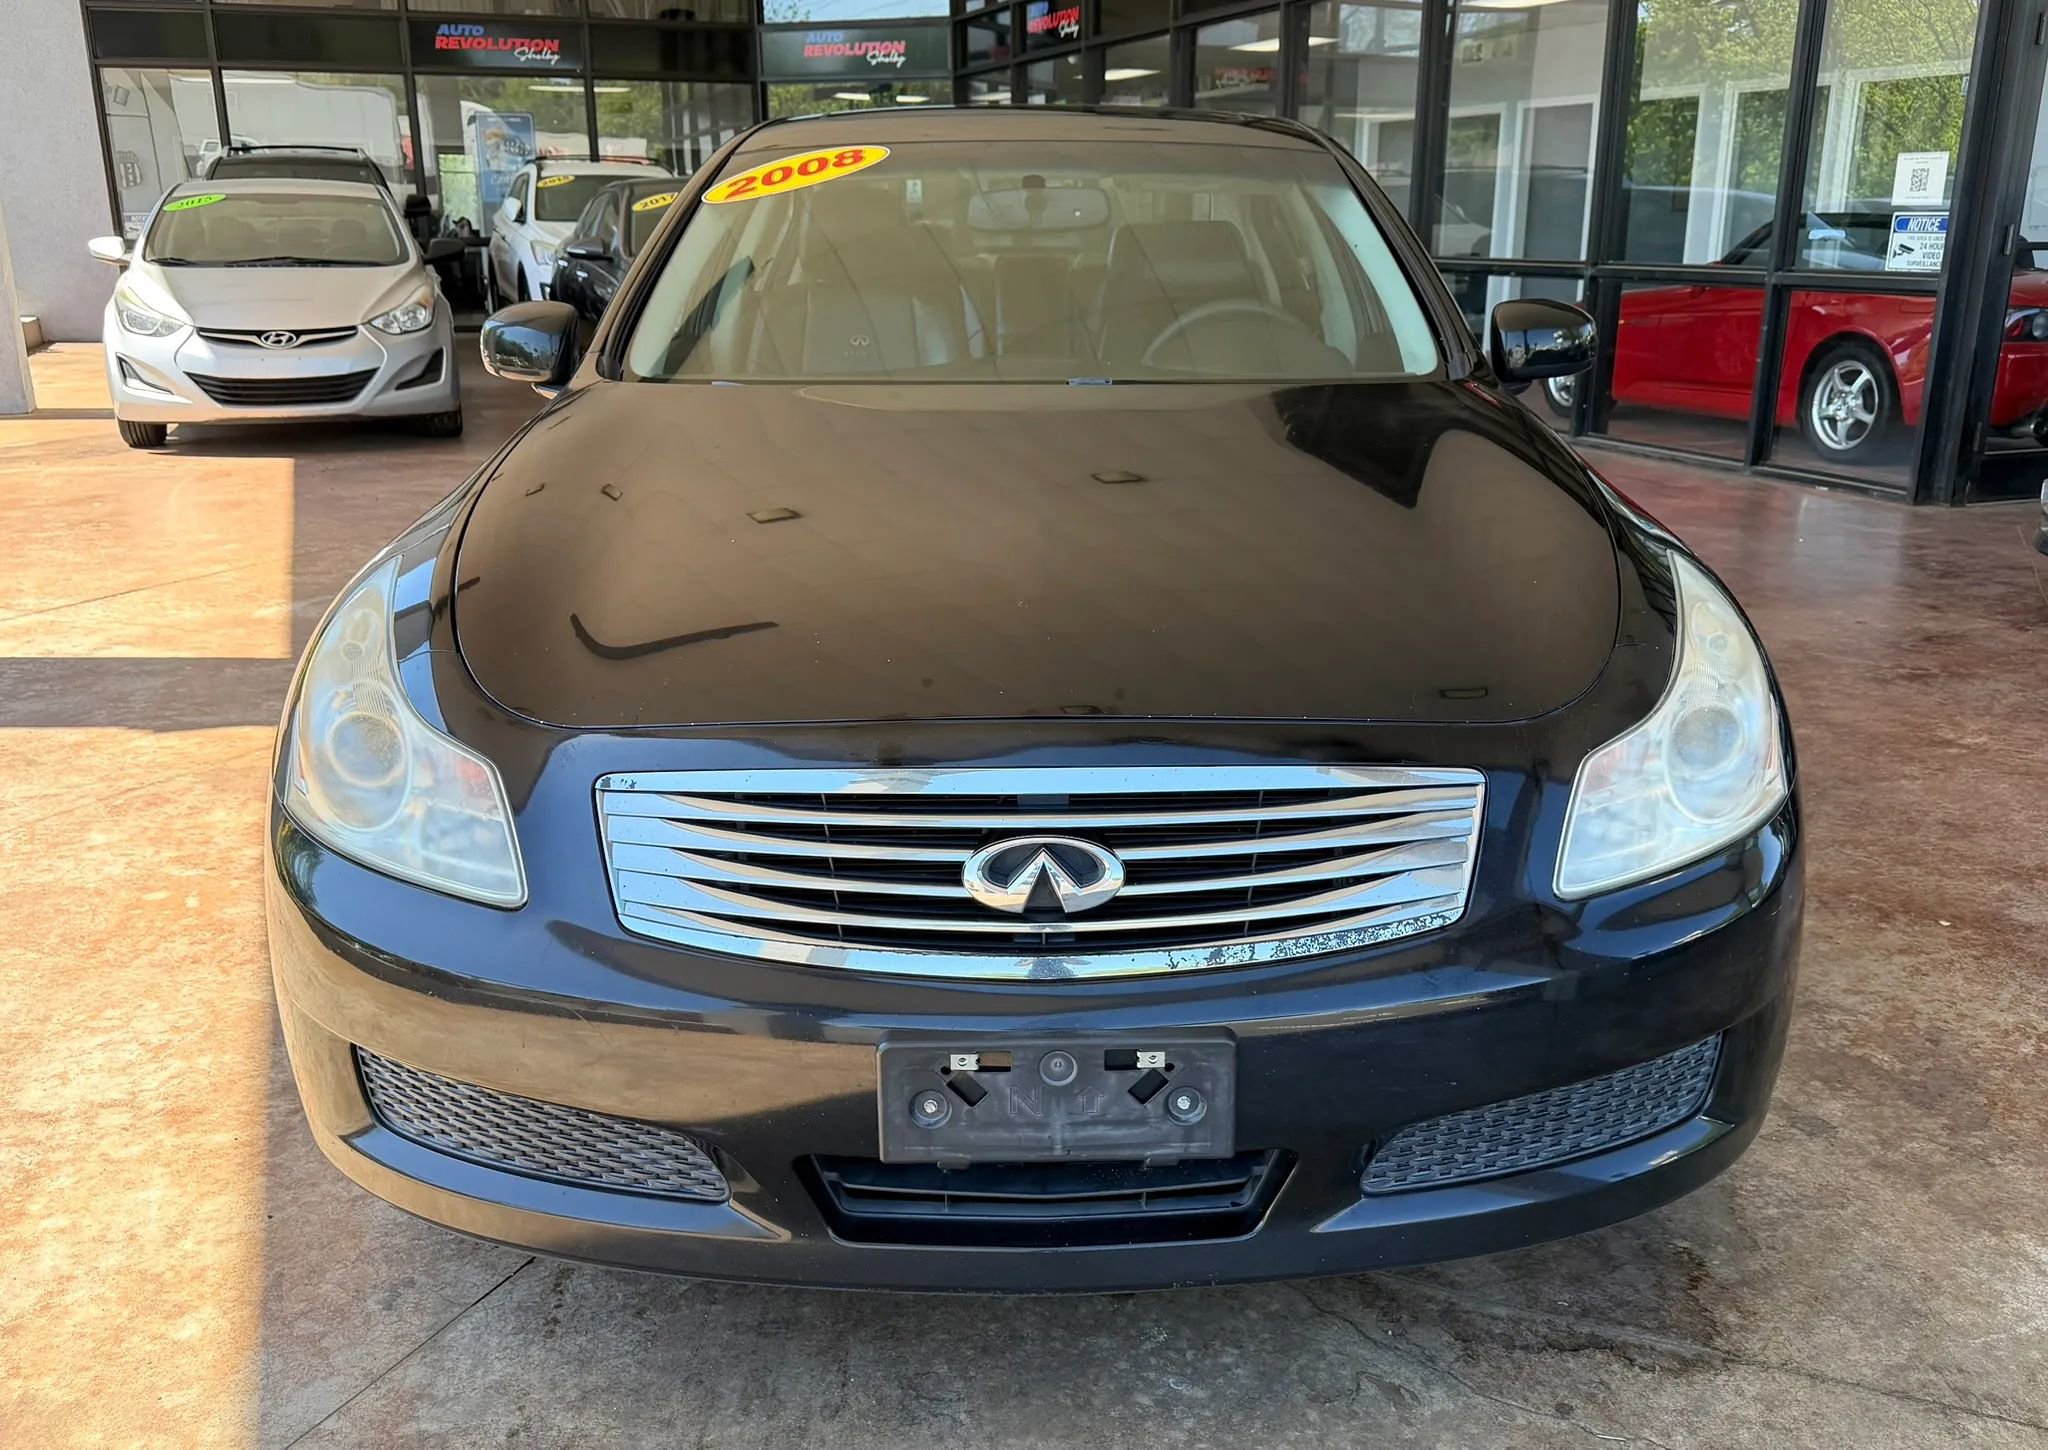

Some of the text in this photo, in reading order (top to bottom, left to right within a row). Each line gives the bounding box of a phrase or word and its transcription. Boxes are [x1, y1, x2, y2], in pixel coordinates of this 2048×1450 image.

[437, 24, 485, 36] AUTO
[435, 36, 560, 52] REVOLUTION
[806, 32, 844, 44] AUTO
[514, 46, 560, 65] Shelby
[804, 40, 906, 57] REVOLUTION
[866, 49, 907, 68] Shelby
[724, 149, 866, 200] 2008
[640, 193, 675, 208] 2017
[1907, 217, 1942, 231] NOTICE
[1919, 242, 1928, 250] 24
[1922, 251, 1941, 260] VIDEO
